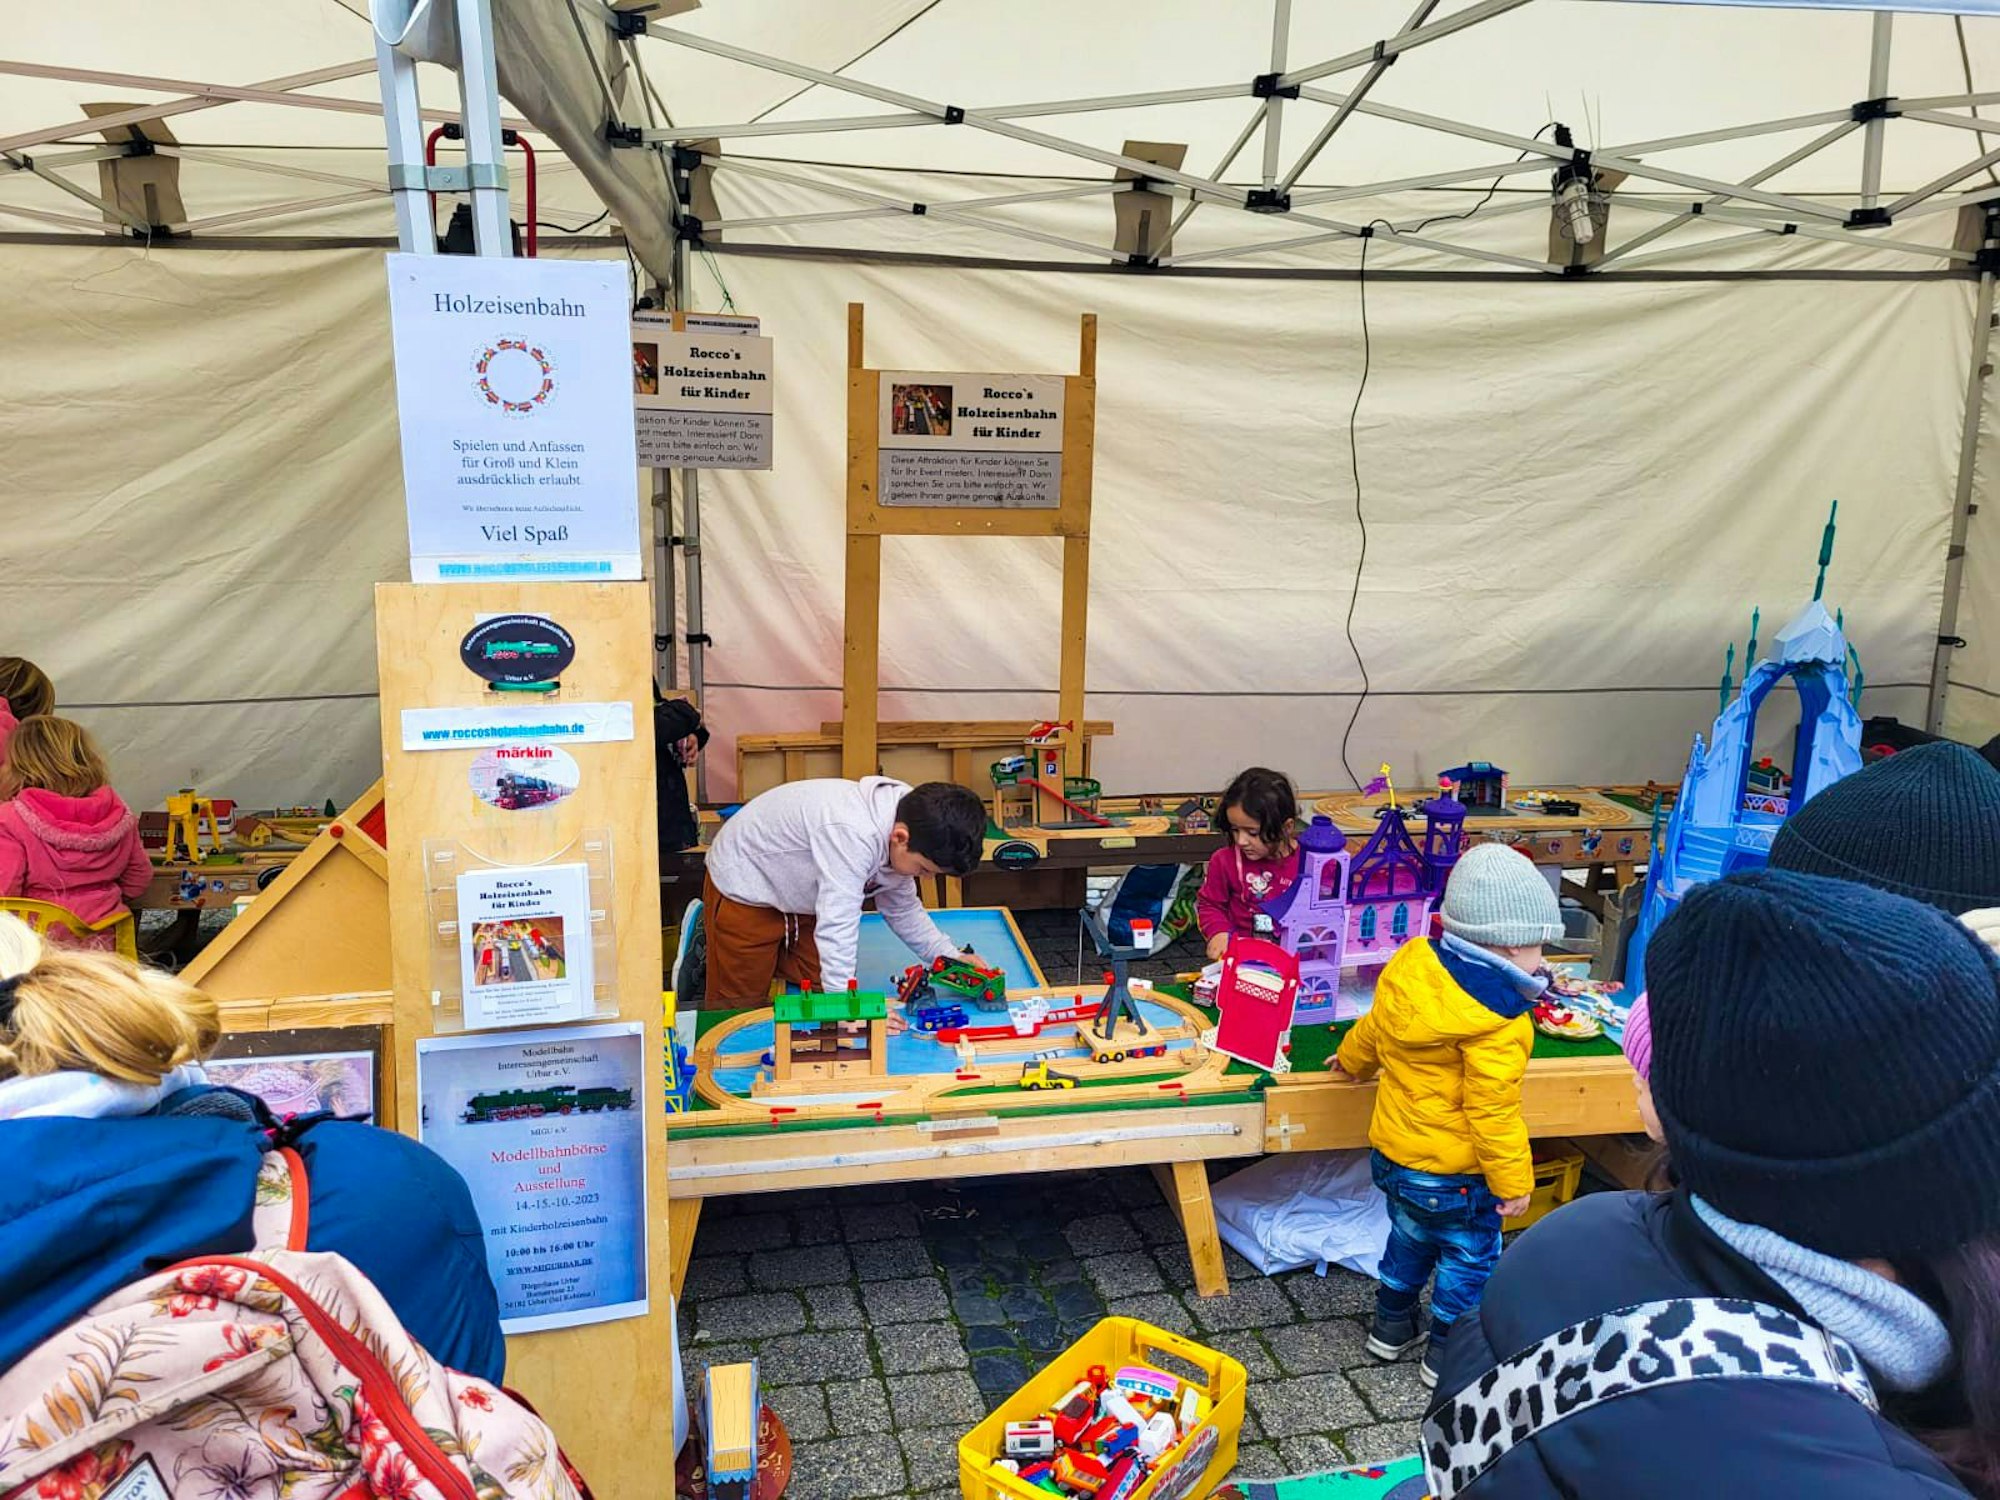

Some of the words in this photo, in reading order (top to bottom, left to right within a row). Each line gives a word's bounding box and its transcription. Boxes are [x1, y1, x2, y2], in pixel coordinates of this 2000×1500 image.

[434, 293, 586, 317] Holzeisenbahn
[664, 366, 767, 381] Holzeisenbahn
[680, 386, 702, 397] für
[704, 387, 750, 399] Kinder
[957, 406, 1057, 420] Holzeisenbahn
[683, 418, 710, 426] Kinder
[747, 420, 760, 428] Sie
[972, 427, 993, 437] für
[995, 427, 1041, 438] Kinder
[453, 440, 500, 454] Spielen
[503, 440, 526, 452] und
[529, 440, 585, 453] Anfassen
[462, 456, 480, 468] für
[483, 457, 515, 468] Groß
[519, 458, 542, 469] und
[545, 458, 579, 469] Klein
[891, 455, 915, 464] Diese
[974, 456, 1002, 465] Kinder
[1036, 458, 1049, 466] Sie
[457, 474, 535, 485] ausdrücklich
[480, 525, 518, 541] Viel
[524, 525, 569, 546] Spaß
[496, 746, 553, 759] märklin
[522, 1044, 575, 1058] Modellbahn
[498, 1054, 600, 1070] Interessengemeinschaft
[526, 1070, 551, 1079] Urbar
[491, 1142, 607, 1164] Modellbahnbörse
[538, 1163, 561, 1175] und
[514, 1176, 586, 1194] Ausstellung
[490, 1225, 507, 1236] mit
[506, 1247, 530, 1258] 10:00
[533, 1246, 547, 1255] bis
[550, 1242, 574, 1253] 16:00
[576, 1240, 595, 1249] Uhr
